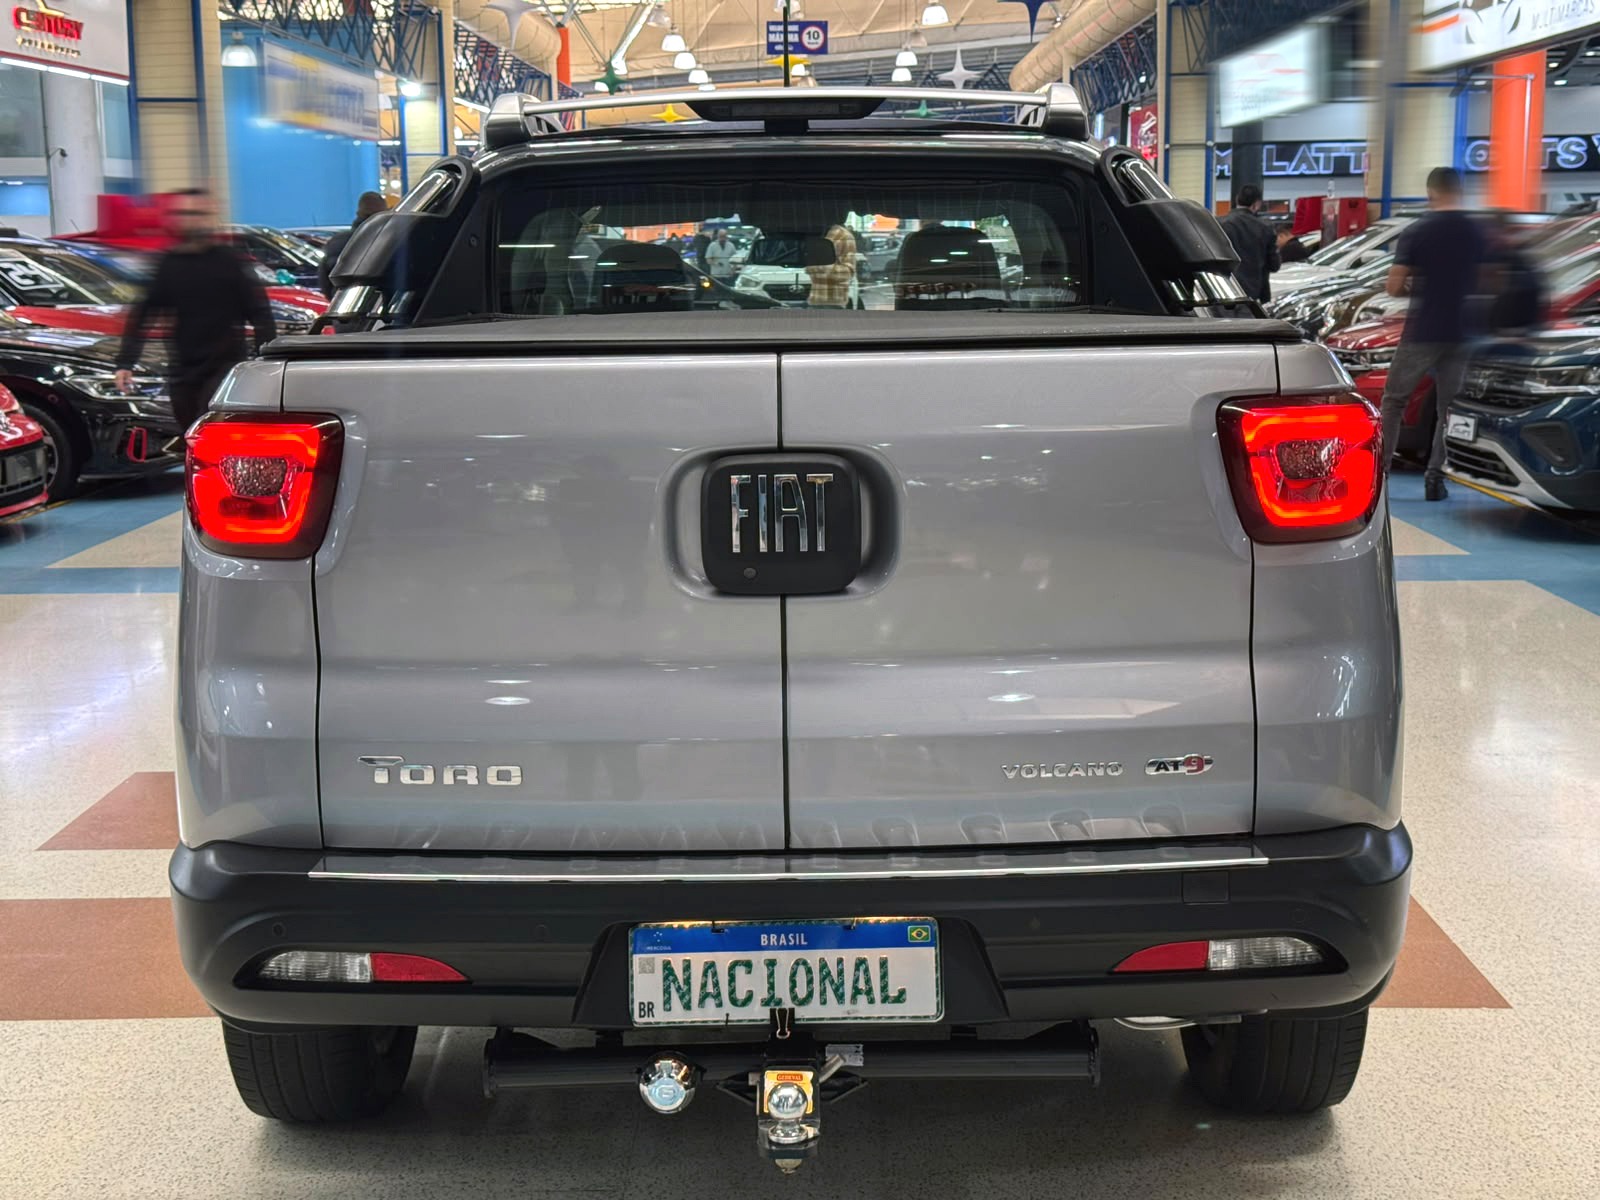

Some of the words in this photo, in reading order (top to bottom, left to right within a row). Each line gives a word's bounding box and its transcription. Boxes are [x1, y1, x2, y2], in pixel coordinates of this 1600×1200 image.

[806, 31, 820, 40] 10
[731, 473, 833, 553] FIAT
[357, 755, 522, 786] TORO
[1001, 761, 1124, 779] VOLCANO
[1153, 753, 1206, 776] AT9
[760, 933, 808, 946] BRASIL
[662, 955, 907, 1012] NACIONAL
[638, 1001, 655, 1018] BR
